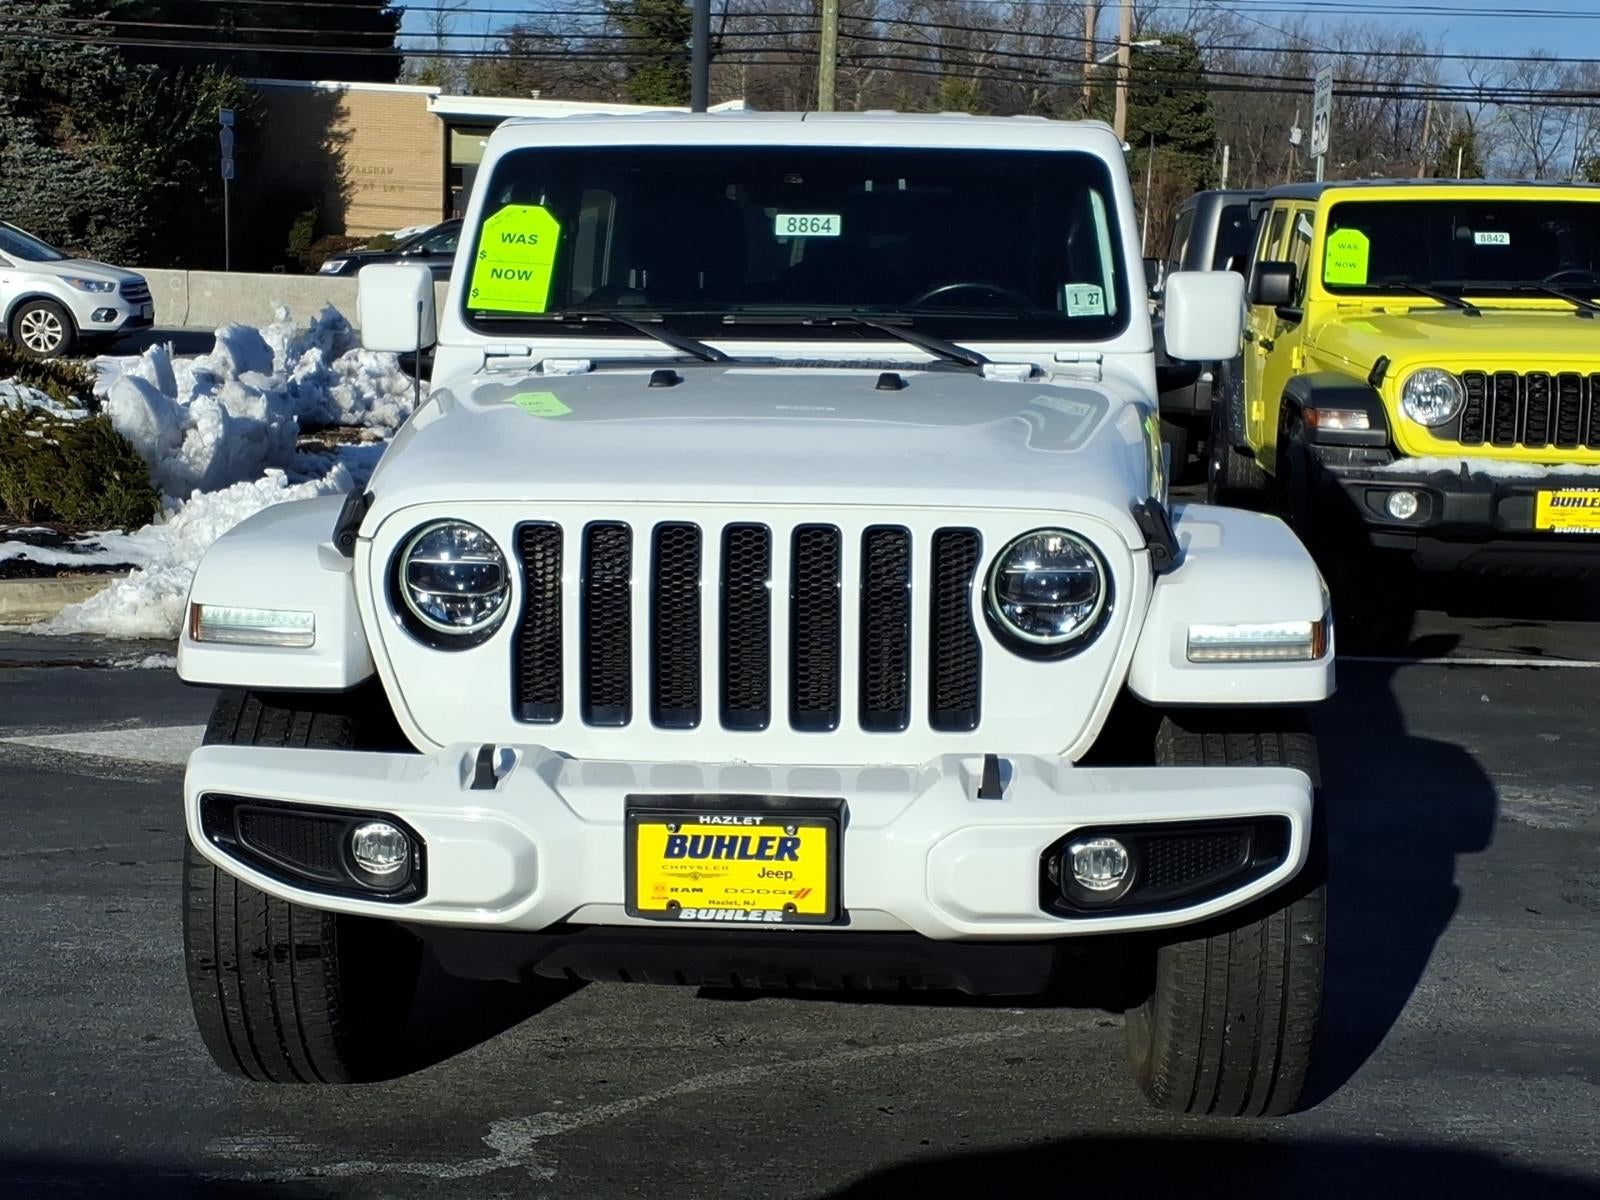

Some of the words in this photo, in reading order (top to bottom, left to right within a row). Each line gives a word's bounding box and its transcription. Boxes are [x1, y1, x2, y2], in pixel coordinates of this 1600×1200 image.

[1314, 111, 1328, 146] 50
[786, 216, 832, 233] 8864
[501, 232, 539, 245] WAS
[1480, 234, 1505, 243] 8842
[479, 249, 487, 260] $
[1335, 261, 1358, 269] NOW
[490, 268, 533, 281] NOW
[471, 287, 480, 298] $
[1073, 292, 1080, 305] 1
[1088, 292, 1100, 305] 27
[1550, 497, 1600, 507] BUHLE
[699, 815, 764, 826] HAZLET
[664, 834, 801, 862] BUHLER
[757, 867, 793, 881] Jeep
[669, 886, 704, 894] RAM
[724, 887, 800, 895] DODGE
[708, 899, 741, 907] Hazlet,
[743, 899, 756, 907] NJ
[678, 908, 783, 922] BUHLER
